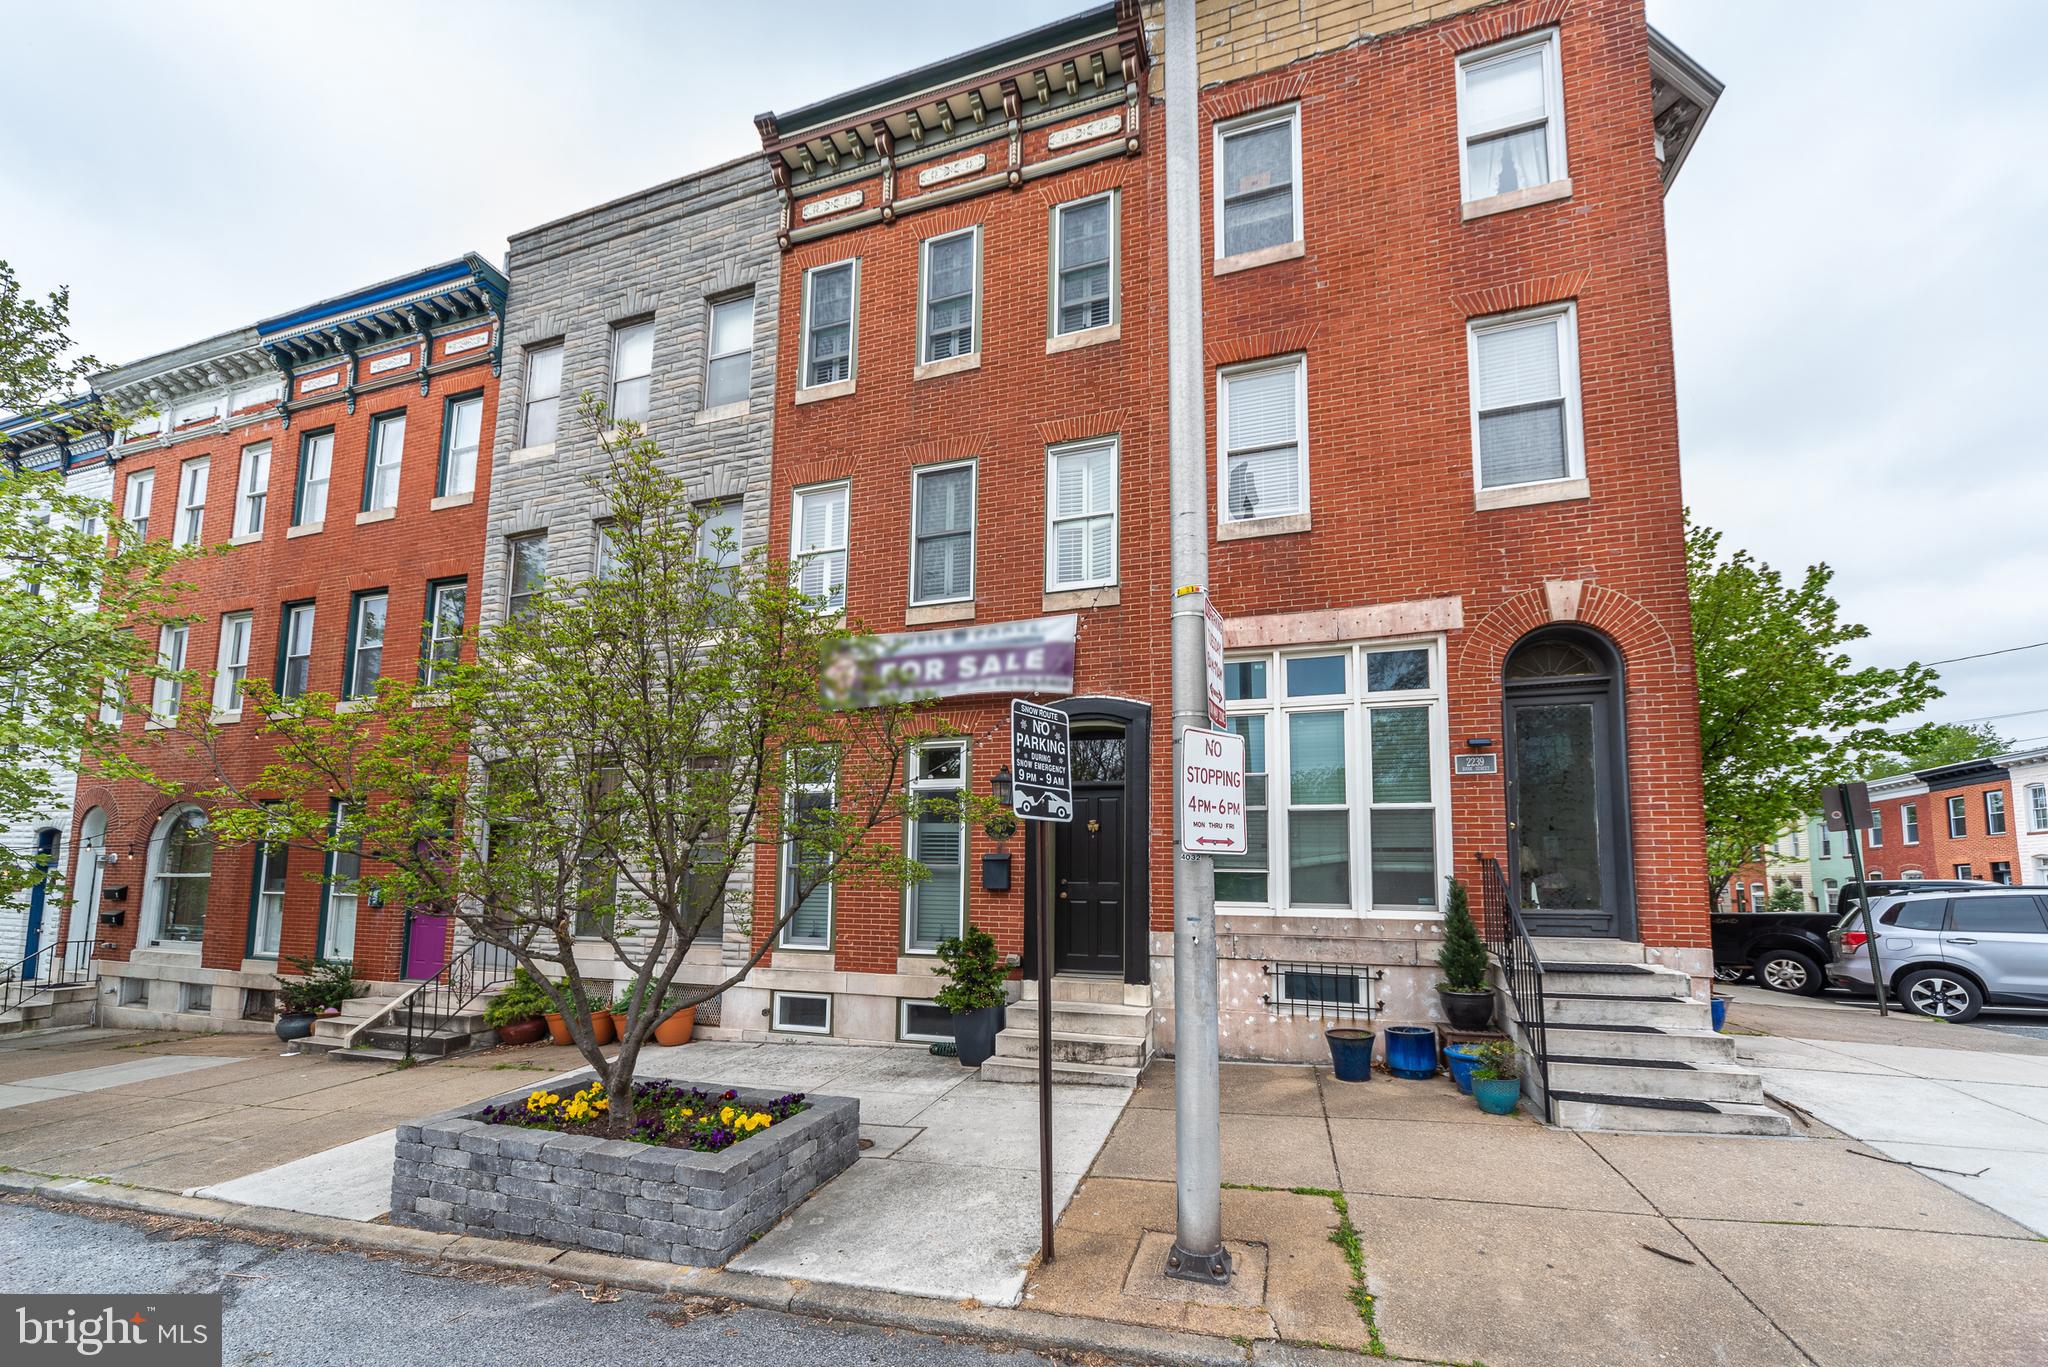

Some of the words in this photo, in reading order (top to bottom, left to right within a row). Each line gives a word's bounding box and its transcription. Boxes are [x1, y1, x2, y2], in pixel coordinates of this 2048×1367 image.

[881, 656, 945, 684] FOR
[958, 649, 1045, 678] SALE
[1021, 704, 1038, 715] SNOW
[1039, 709, 1058, 720] ROUTE
[1033, 719, 1050, 735] NO
[1016, 732, 1065, 755] PARKING
[1205, 738, 1222, 757] NO
[1031, 752, 1052, 763] DURING
[1466, 757, 1484, 766] 2239
[1016, 758, 1033, 769] SNOW
[1034, 762, 1066, 774] EMERGENCY
[1187, 765, 1241, 788] STOPPING
